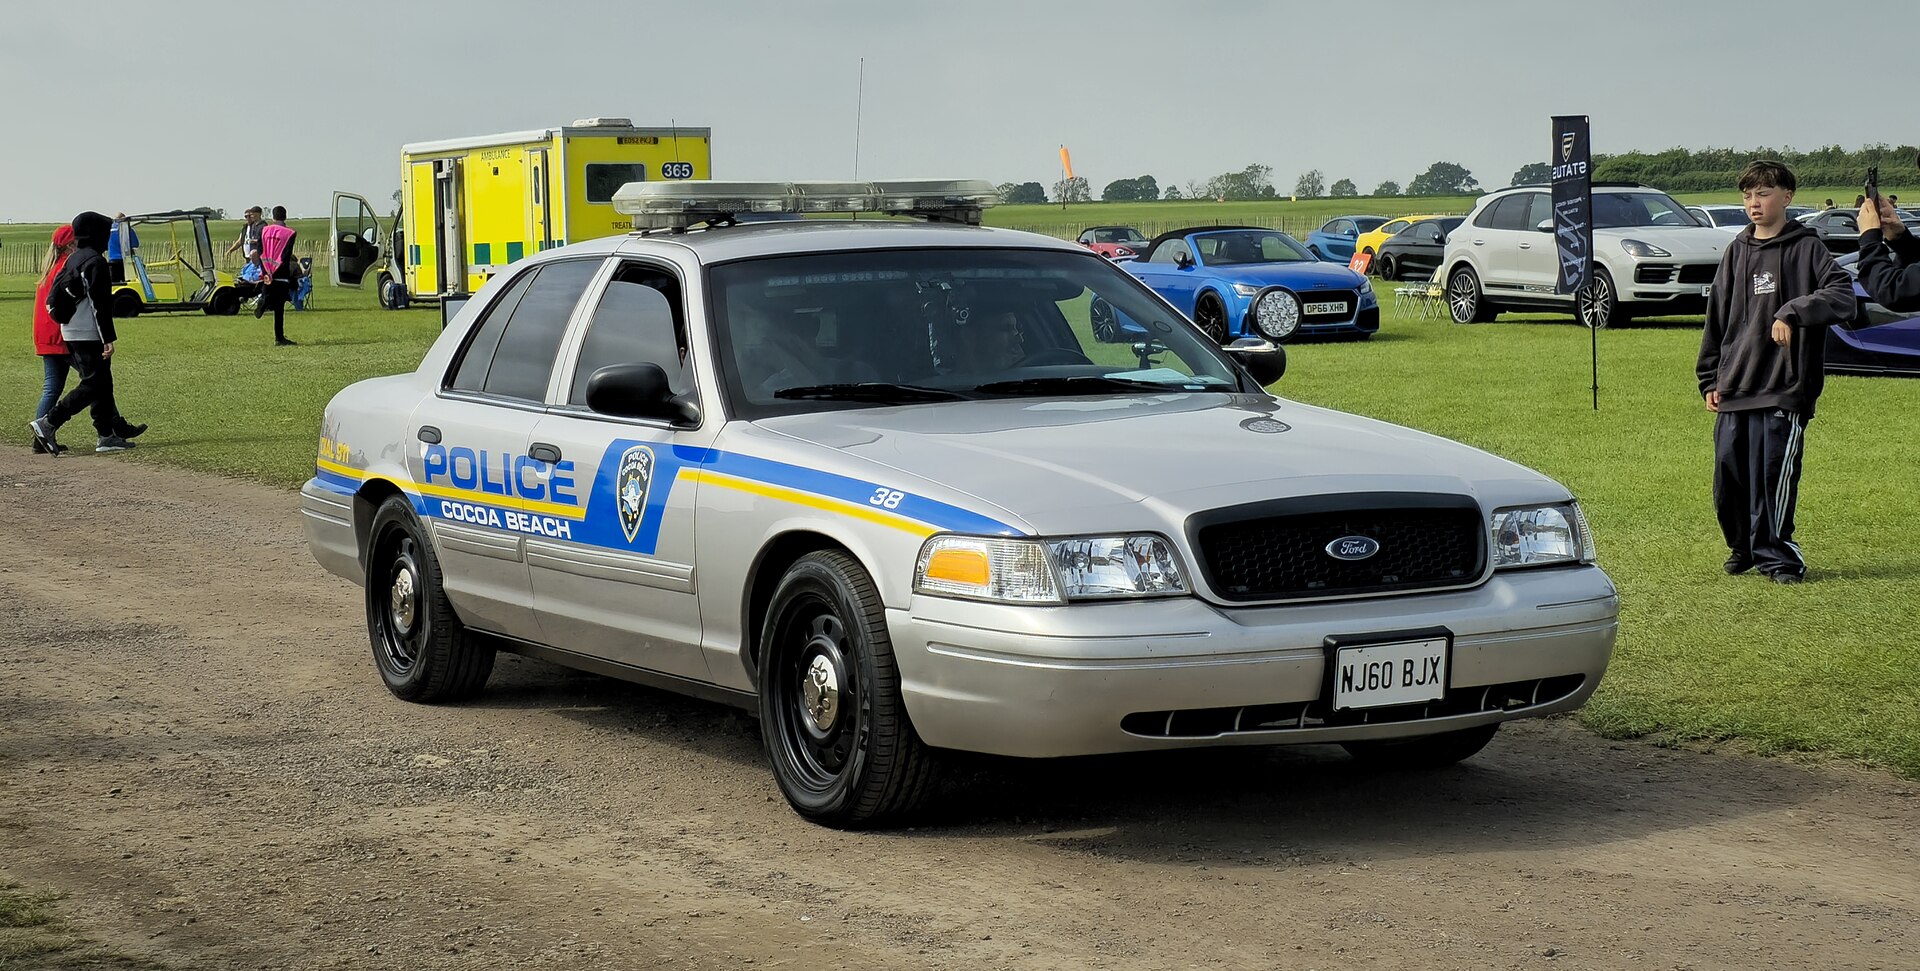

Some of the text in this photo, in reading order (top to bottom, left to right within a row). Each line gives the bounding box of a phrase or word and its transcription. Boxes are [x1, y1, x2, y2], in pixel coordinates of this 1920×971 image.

[480, 149, 511, 161] AMBULANCE
[664, 164, 690, 177] 365
[1306, 303, 1344, 313] DP66 XHR
[628, 451, 649, 467] POLICE
[424, 444, 579, 506] POLICE
[869, 487, 905, 509] 38
[441, 500, 571, 539] COCOA BEACH
[1340, 540, 1368, 555] Ford
[1341, 656, 1441, 693] NJ60 BJX
